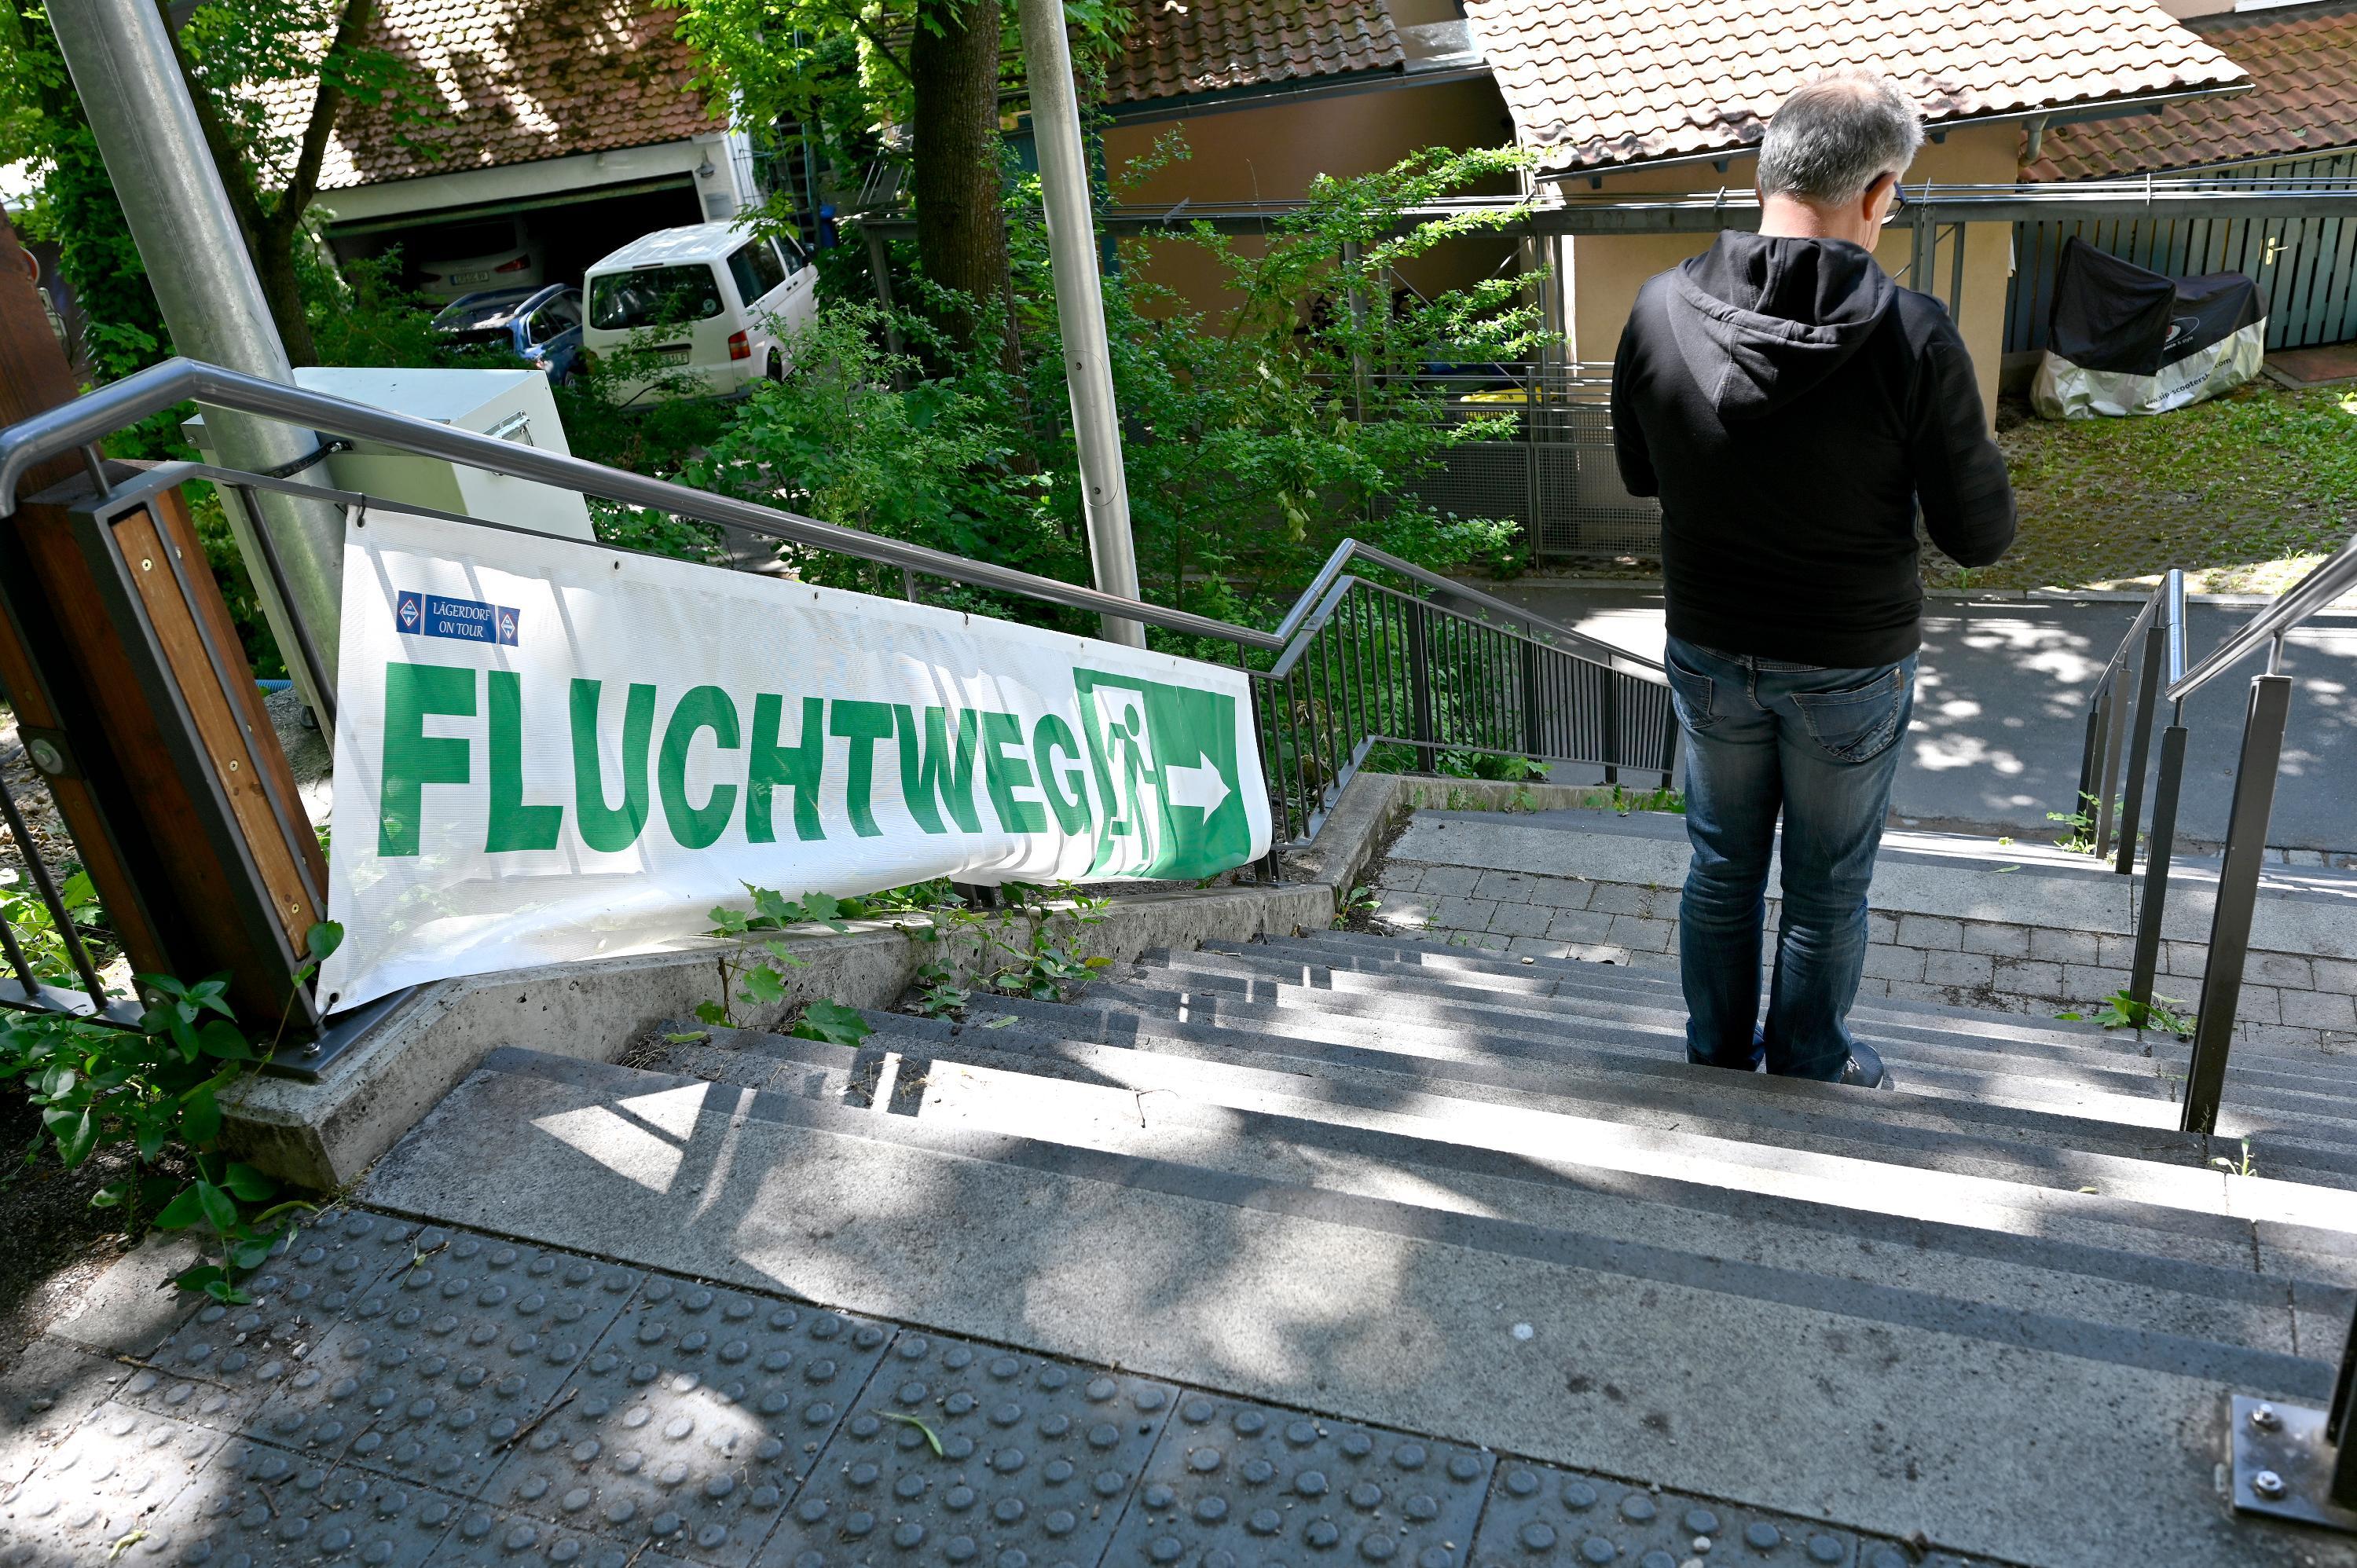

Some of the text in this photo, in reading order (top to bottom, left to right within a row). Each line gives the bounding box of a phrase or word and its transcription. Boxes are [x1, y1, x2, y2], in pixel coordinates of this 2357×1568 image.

[433, 601, 490, 621] LÄGERDORF
[438, 621, 484, 638] ON TOUR
[379, 663, 1091, 856] FLUCHTWEG
